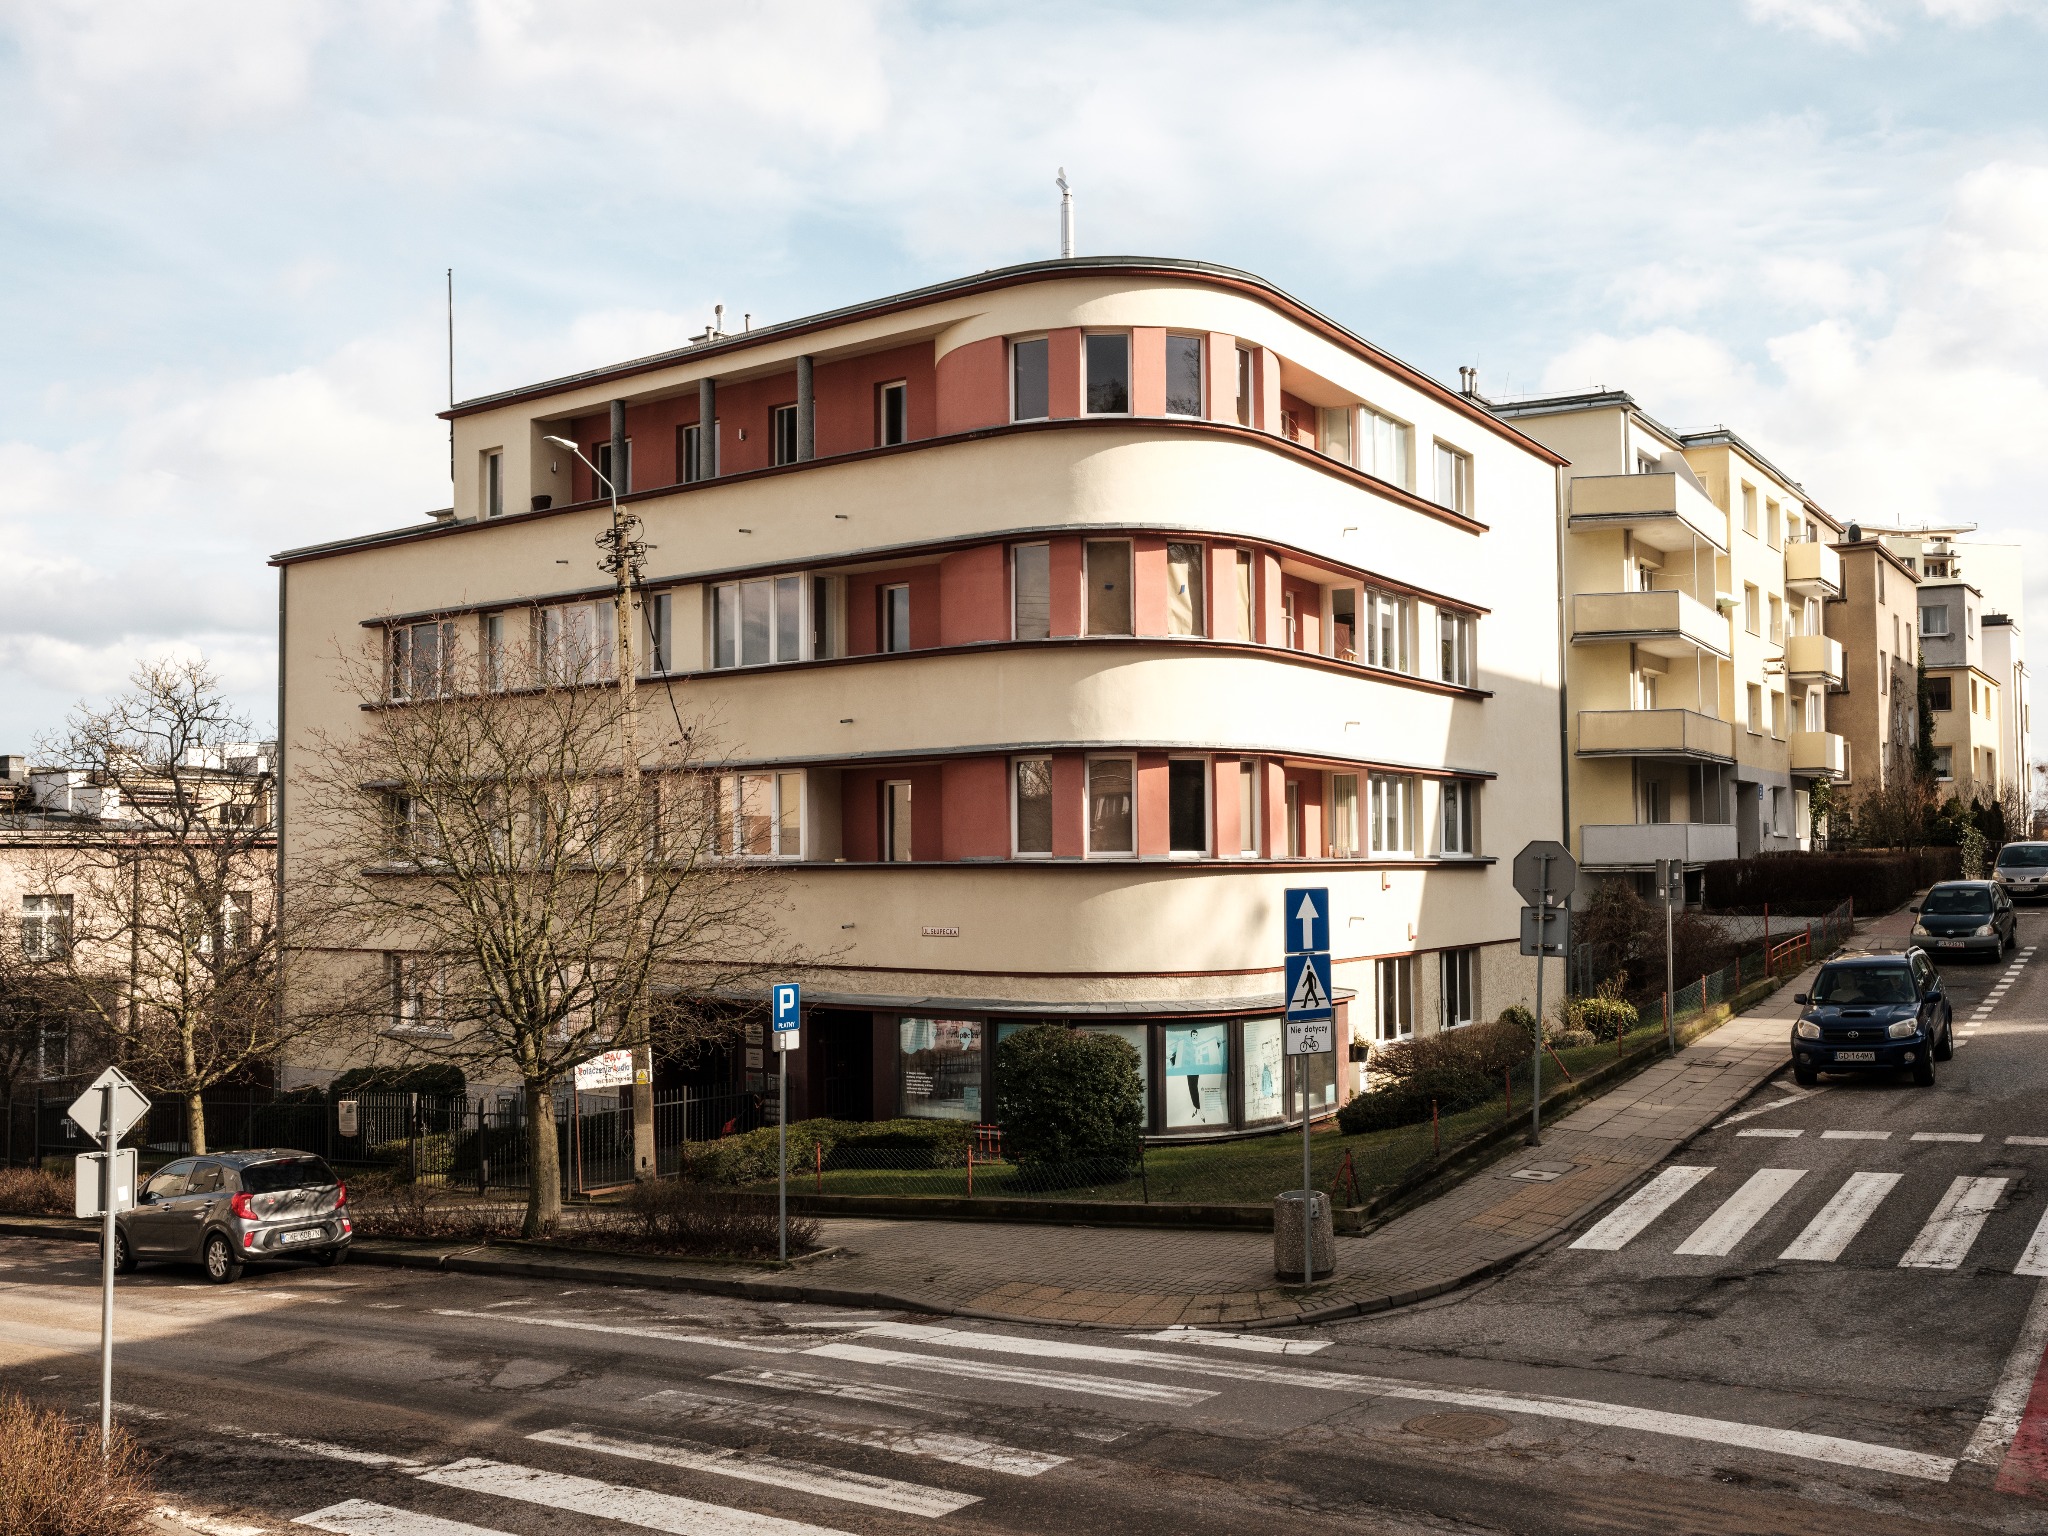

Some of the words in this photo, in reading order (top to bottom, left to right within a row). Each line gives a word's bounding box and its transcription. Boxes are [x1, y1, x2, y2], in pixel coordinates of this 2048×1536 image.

[780, 988, 794, 1017] P
[1290, 1026, 1301, 1034] Nie
[1304, 1025, 1328, 1035] dotyczy
[1838, 1052, 1850, 1060] GD
